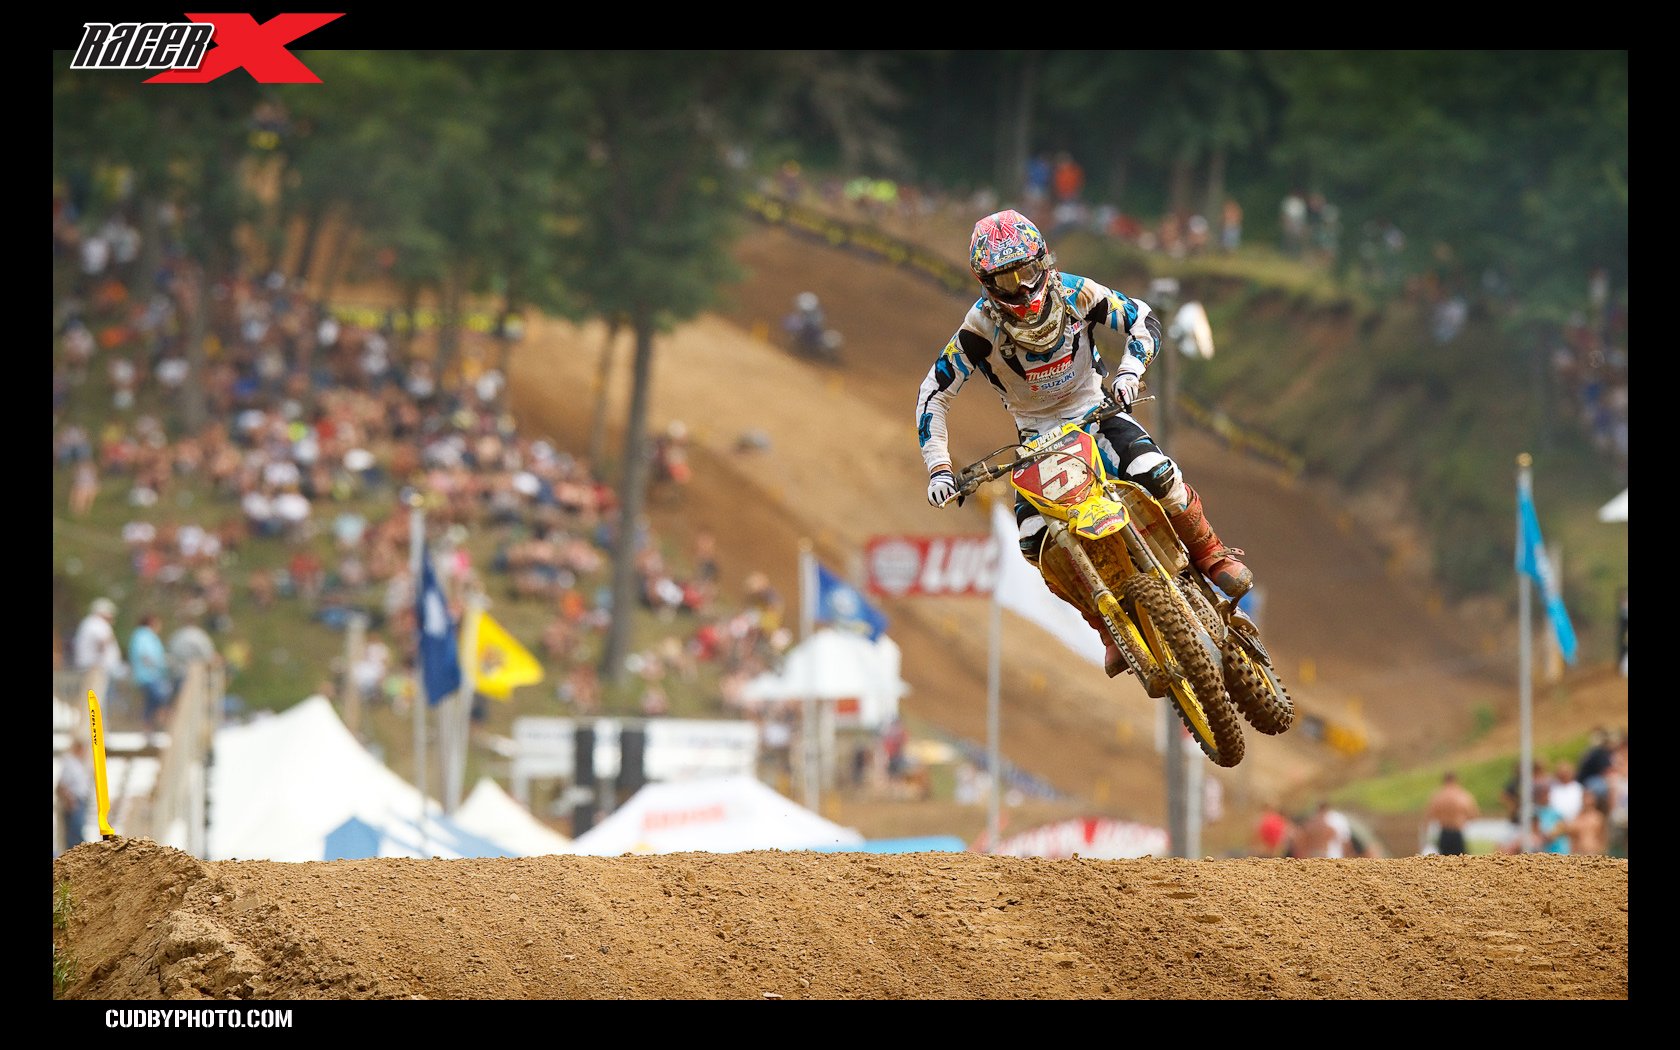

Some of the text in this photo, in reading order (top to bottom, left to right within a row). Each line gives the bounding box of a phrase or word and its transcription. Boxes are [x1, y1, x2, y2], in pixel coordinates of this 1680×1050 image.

[1041, 371, 1075, 390] SUZUKI
[1038, 442, 1088, 501] 5
[1102, 614, 1142, 672] DUNLOP
